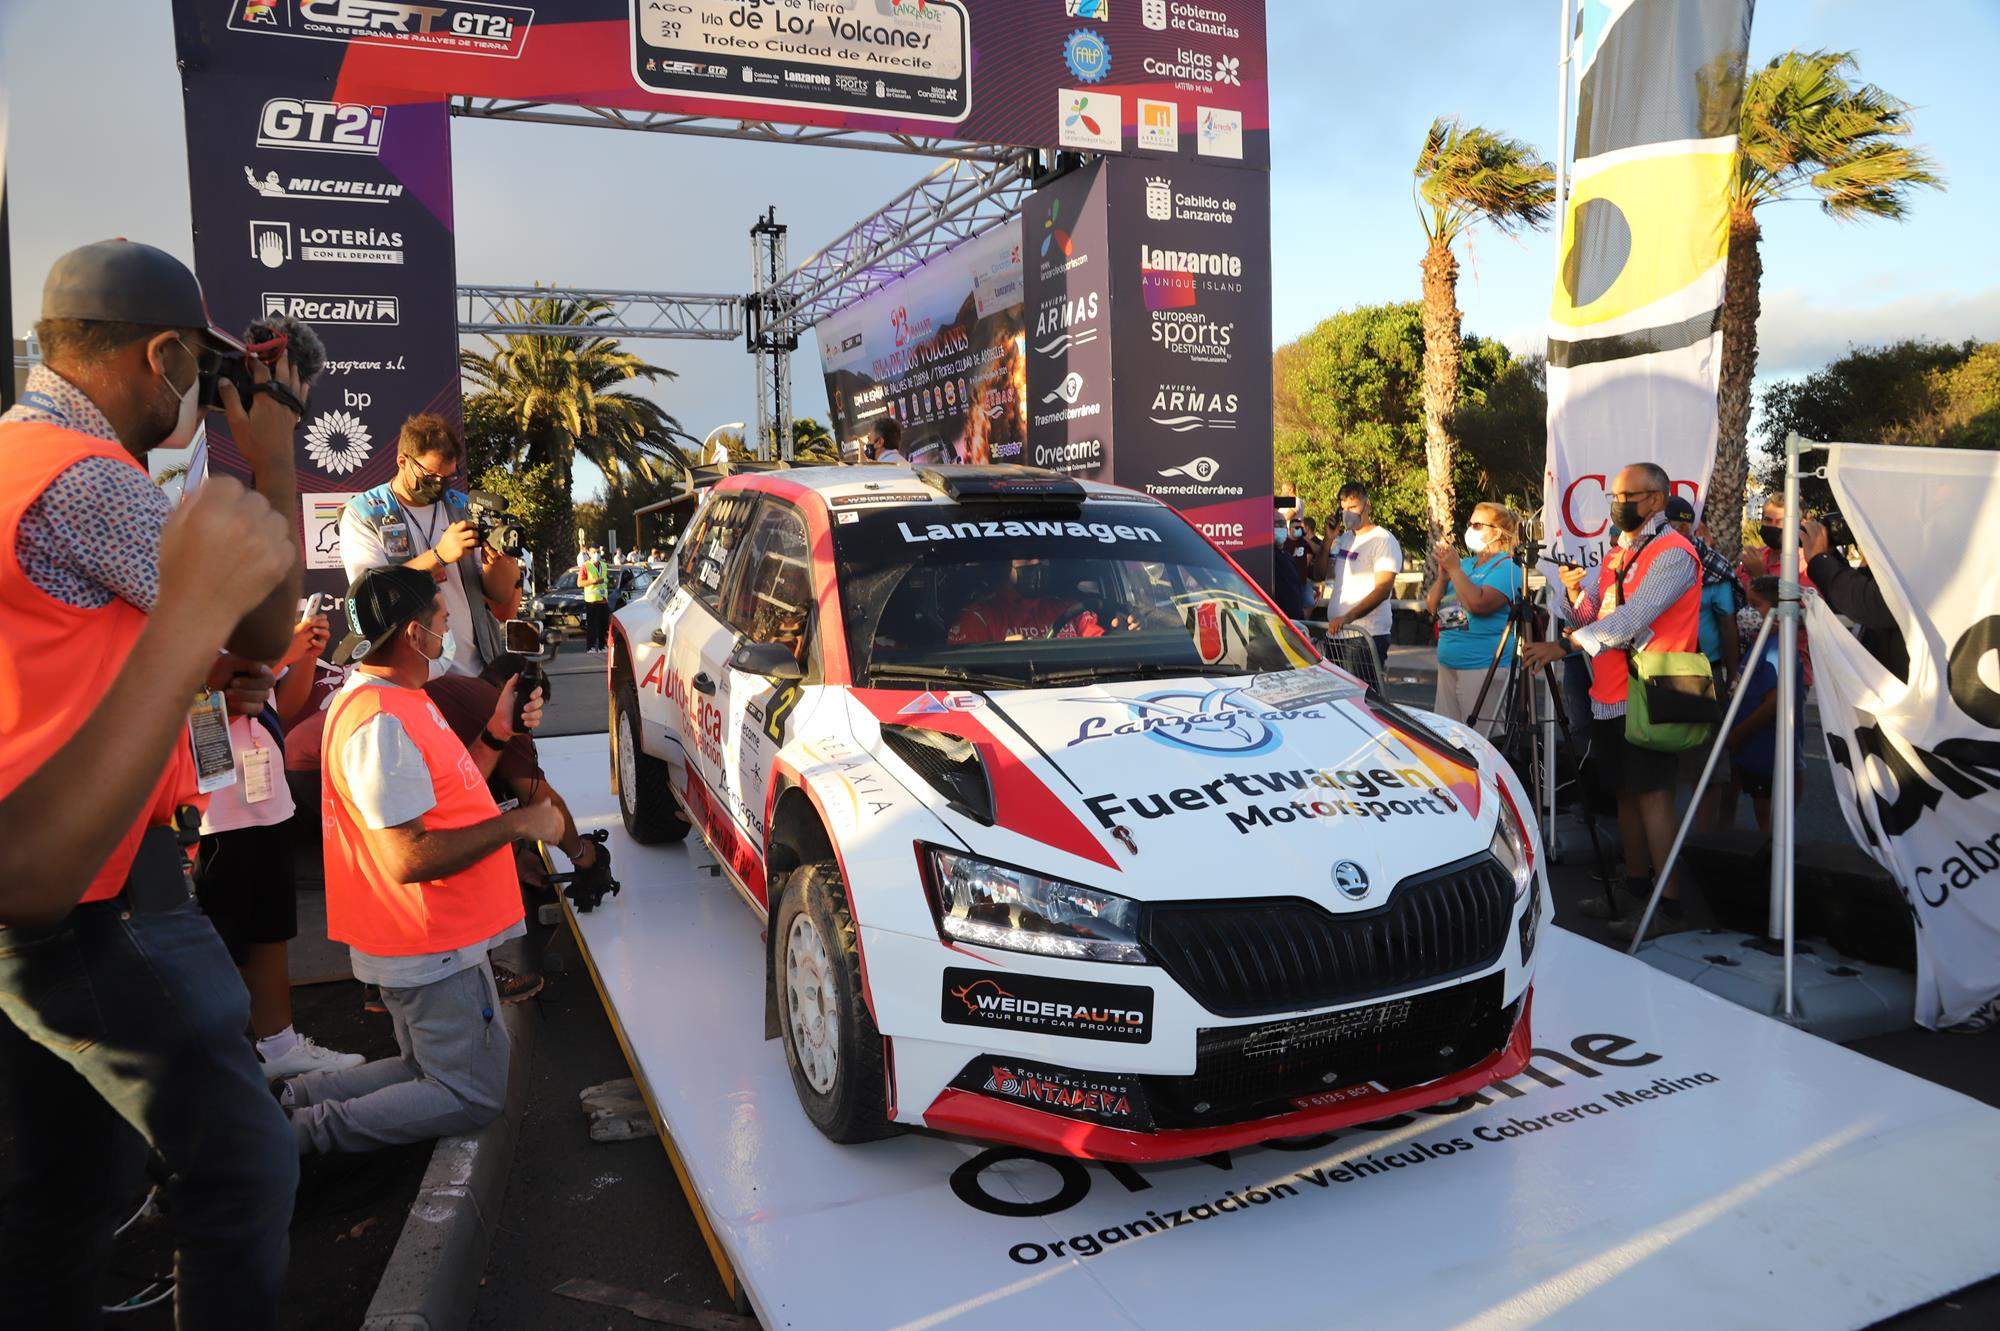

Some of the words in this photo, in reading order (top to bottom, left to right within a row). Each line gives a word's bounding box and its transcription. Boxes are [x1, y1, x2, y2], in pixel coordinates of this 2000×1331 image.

[649, 2, 693, 14] AGO
[808, 0, 844, 14] Tierra
[1170, 2, 1227, 22] Gobierno
[453, 12, 514, 37] GT2i
[661, 21, 682, 30] 20
[661, 30, 679, 38] 21
[702, 12, 723, 26] Isla
[729, 7, 763, 29] de
[776, 10, 814, 35] Los
[827, 16, 931, 49] Volcanes
[1171, 16, 1186, 29] de
[1188, 19, 1239, 39] Canarias
[304, 23, 334, 33] COPA
[337, 26, 350, 35] DE
[352, 27, 393, 39] ESPAÑA
[411, 35, 456, 46] RALLYES
[458, 39, 471, 47] DE
[473, 41, 509, 51] TIERRA
[703, 33, 759, 49] Trofeo
[765, 40, 831, 57] Ciudad
[838, 49, 860, 60] de
[866, 52, 932, 70] Arrecife
[1177, 48, 1212, 68] Islas
[662, 60, 706, 73] CERT
[784, 69, 831, 85] Lanzarote
[1143, 58, 1213, 82] Canarias
[835, 79, 868, 91] sports
[262, 99, 384, 146] GT2i
[288, 178, 403, 197] MICHELIN
[1175, 193, 1219, 209] Cabildo
[1222, 197, 1236, 211] de
[1176, 208, 1232, 224] Lanzarote
[300, 226, 403, 248] LOTERÍAS
[313, 250, 333, 259] CON
[336, 252, 347, 260] EL
[350, 253, 393, 262] DEPORTE
[1141, 244, 1242, 277] Lanzarote
[1142, 277, 1149, 286] A
[1155, 277, 1197, 289] UNIQUE
[1202, 282, 1242, 293] ISLAND
[288, 297, 375, 320] Recalvi
[1036, 292, 1098, 337] ARMAS
[1152, 310, 1206, 324] european
[891, 305, 910, 347] 23
[1151, 321, 1231, 349] sports
[919, 329, 969, 364] VOLCANES
[1171, 343, 1226, 355] DESTINATION
[323, 360, 381, 375] nzagrava
[385, 355, 405, 370] s.l.
[344, 388, 371, 411] bp
[1160, 384, 1196, 392] NAVIERA
[1151, 391, 1238, 413] ARMAS
[1035, 440, 1100, 466] Orvecame
[897, 520, 1162, 543] Lanzawagen
[769, 687, 795, 739] 2
[1067, 709, 1327, 748] Lanzagrava
[1082, 766, 1434, 830] Fuertwagen
[1225, 793, 1444, 835] Motorsport
[976, 994, 1144, 1026] WEIDERAUTO
[979, 1012, 1012, 1022] YOUR
[1016, 1015, 1048, 1025] BEST
[1051, 1018, 1076, 1028] CAR
[1080, 1022, 1143, 1035] PROVIDER
[1017, 1068, 1128, 1093] Rotulaciones
[1008, 1178, 1301, 1266] Organización
[1296, 1134, 1474, 1191] Vehículos
[1472, 1097, 1608, 1143] Cabrera
[1605, 1068, 1720, 1110] Medina
